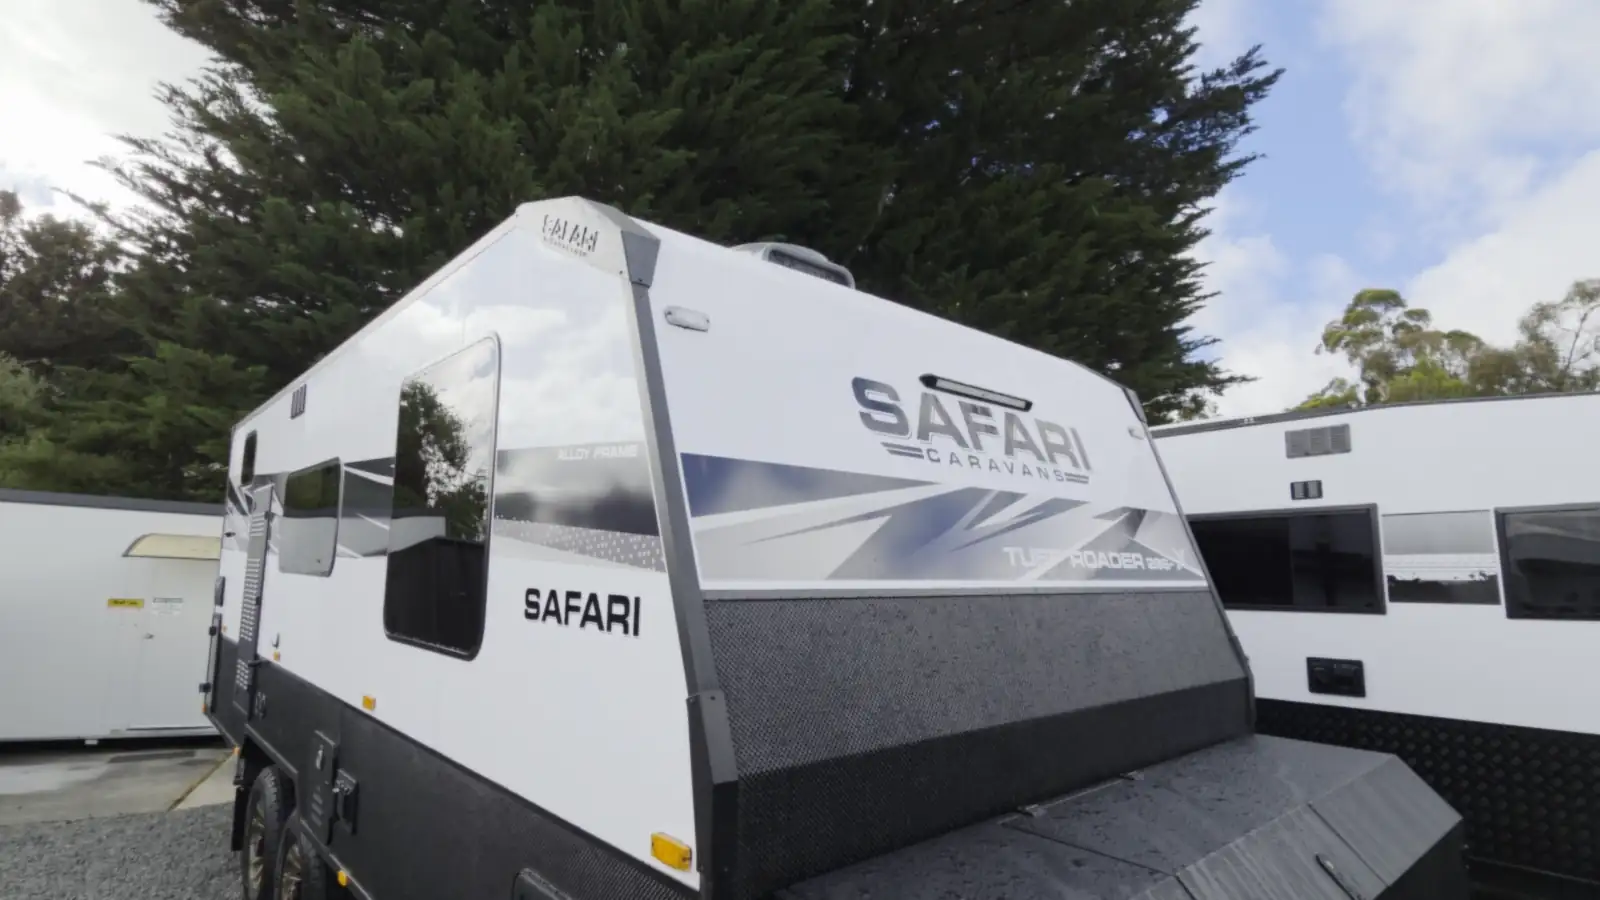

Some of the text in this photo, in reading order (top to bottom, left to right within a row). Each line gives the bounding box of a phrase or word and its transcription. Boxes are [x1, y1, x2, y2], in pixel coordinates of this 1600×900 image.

[851, 376, 1093, 471] SAFARI
[926, 448, 1066, 482] CARAVANS
[1003, 546, 1067, 569] TUF
[1070, 551, 1146, 570] ROADER
[524, 587, 641, 637] SAFARI
